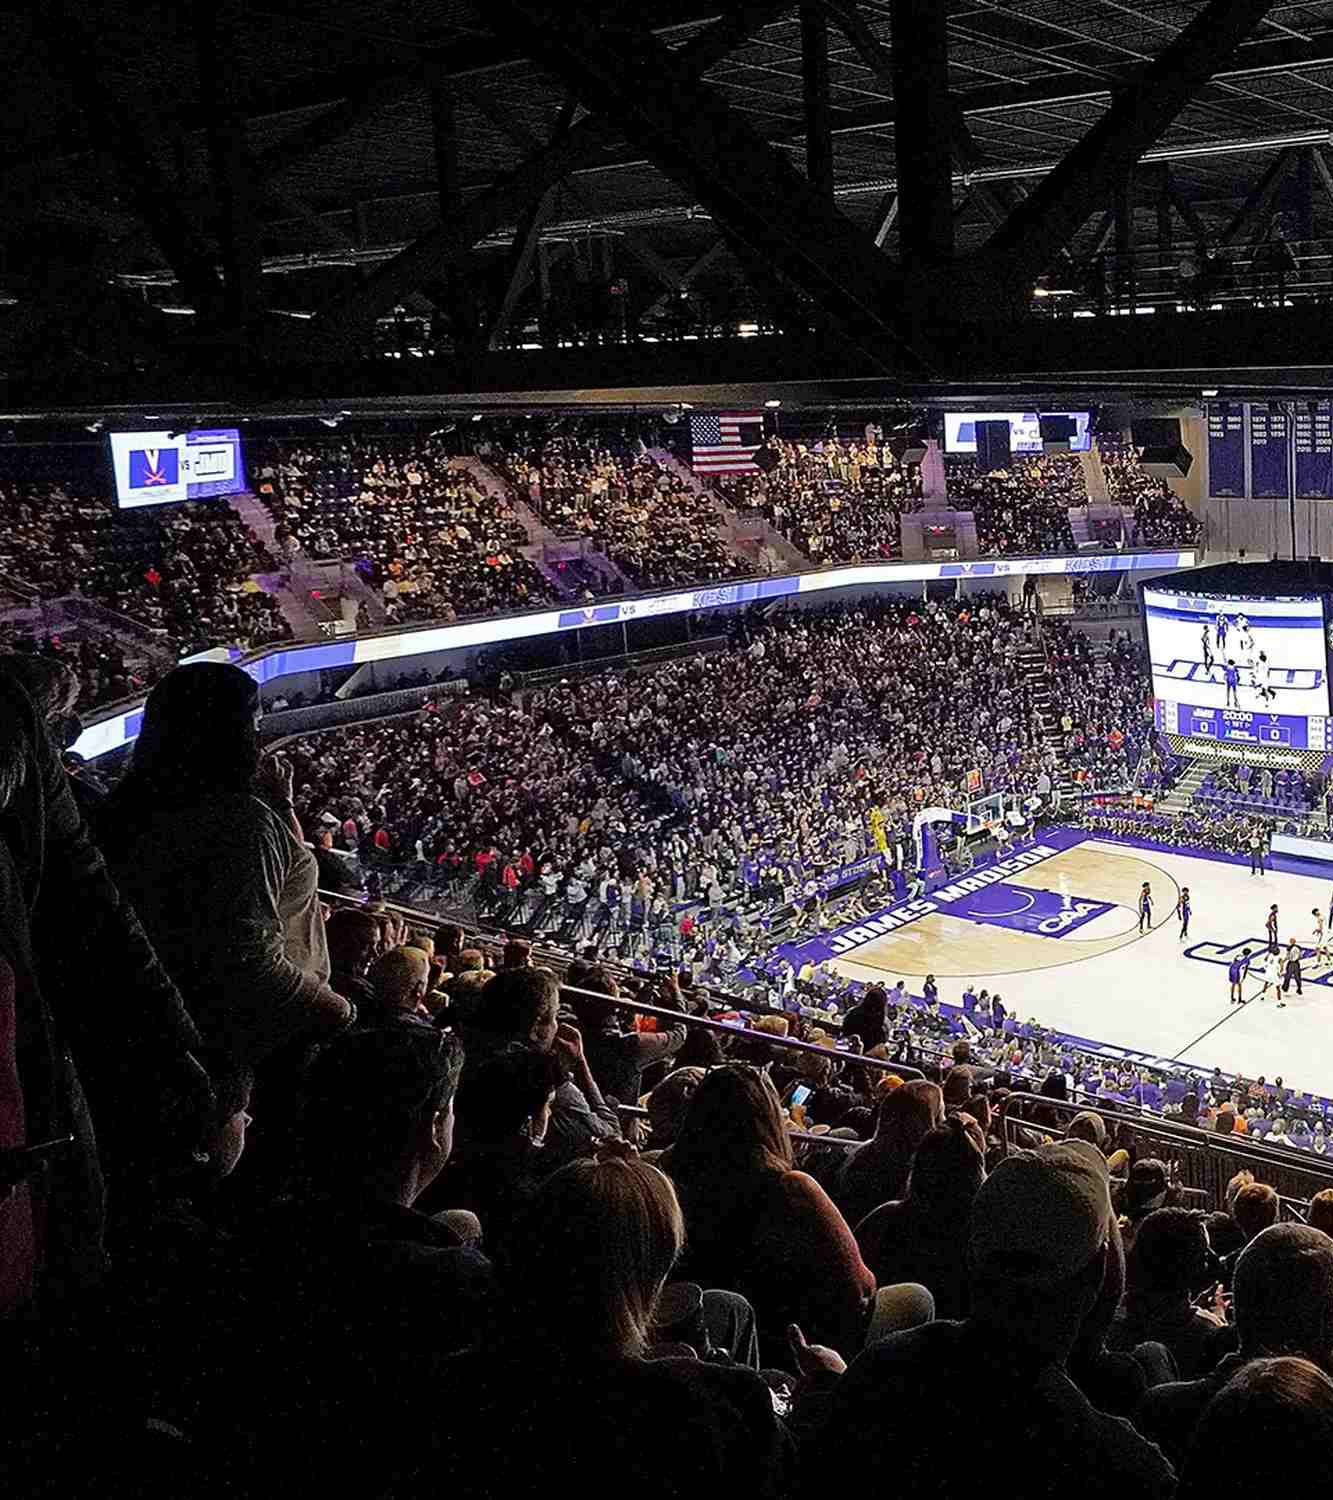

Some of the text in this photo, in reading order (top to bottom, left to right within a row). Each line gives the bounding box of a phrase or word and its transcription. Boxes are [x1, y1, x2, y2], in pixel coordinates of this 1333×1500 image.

[622, 604, 636, 616] VS
[830, 845, 1060, 952] JAMES MADISON
[1039, 902, 1104, 933] CAA
